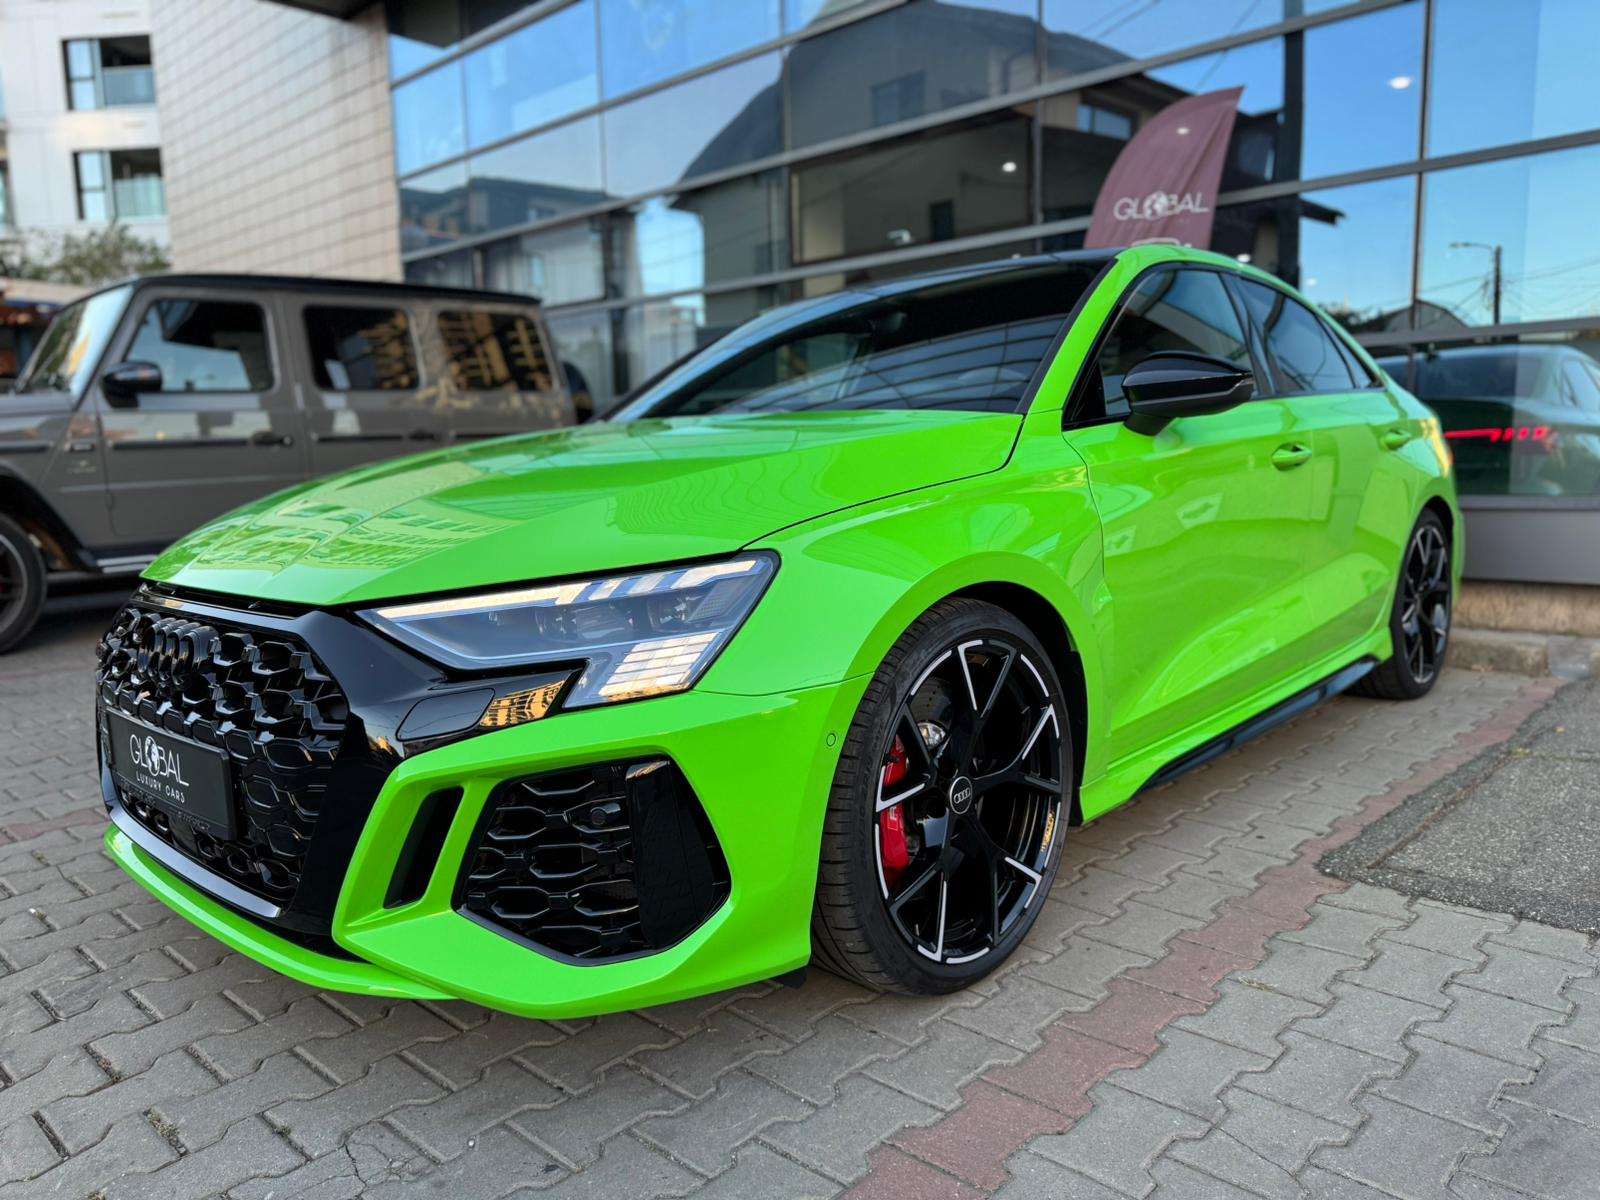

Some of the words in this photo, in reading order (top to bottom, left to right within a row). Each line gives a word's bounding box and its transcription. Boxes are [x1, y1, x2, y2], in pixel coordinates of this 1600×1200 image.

[1113, 190, 1209, 221] GLOBAL
[130, 734, 190, 787] GLOBAL
[136, 771, 161, 791] LUXURY
[165, 785, 185, 803] CARS
